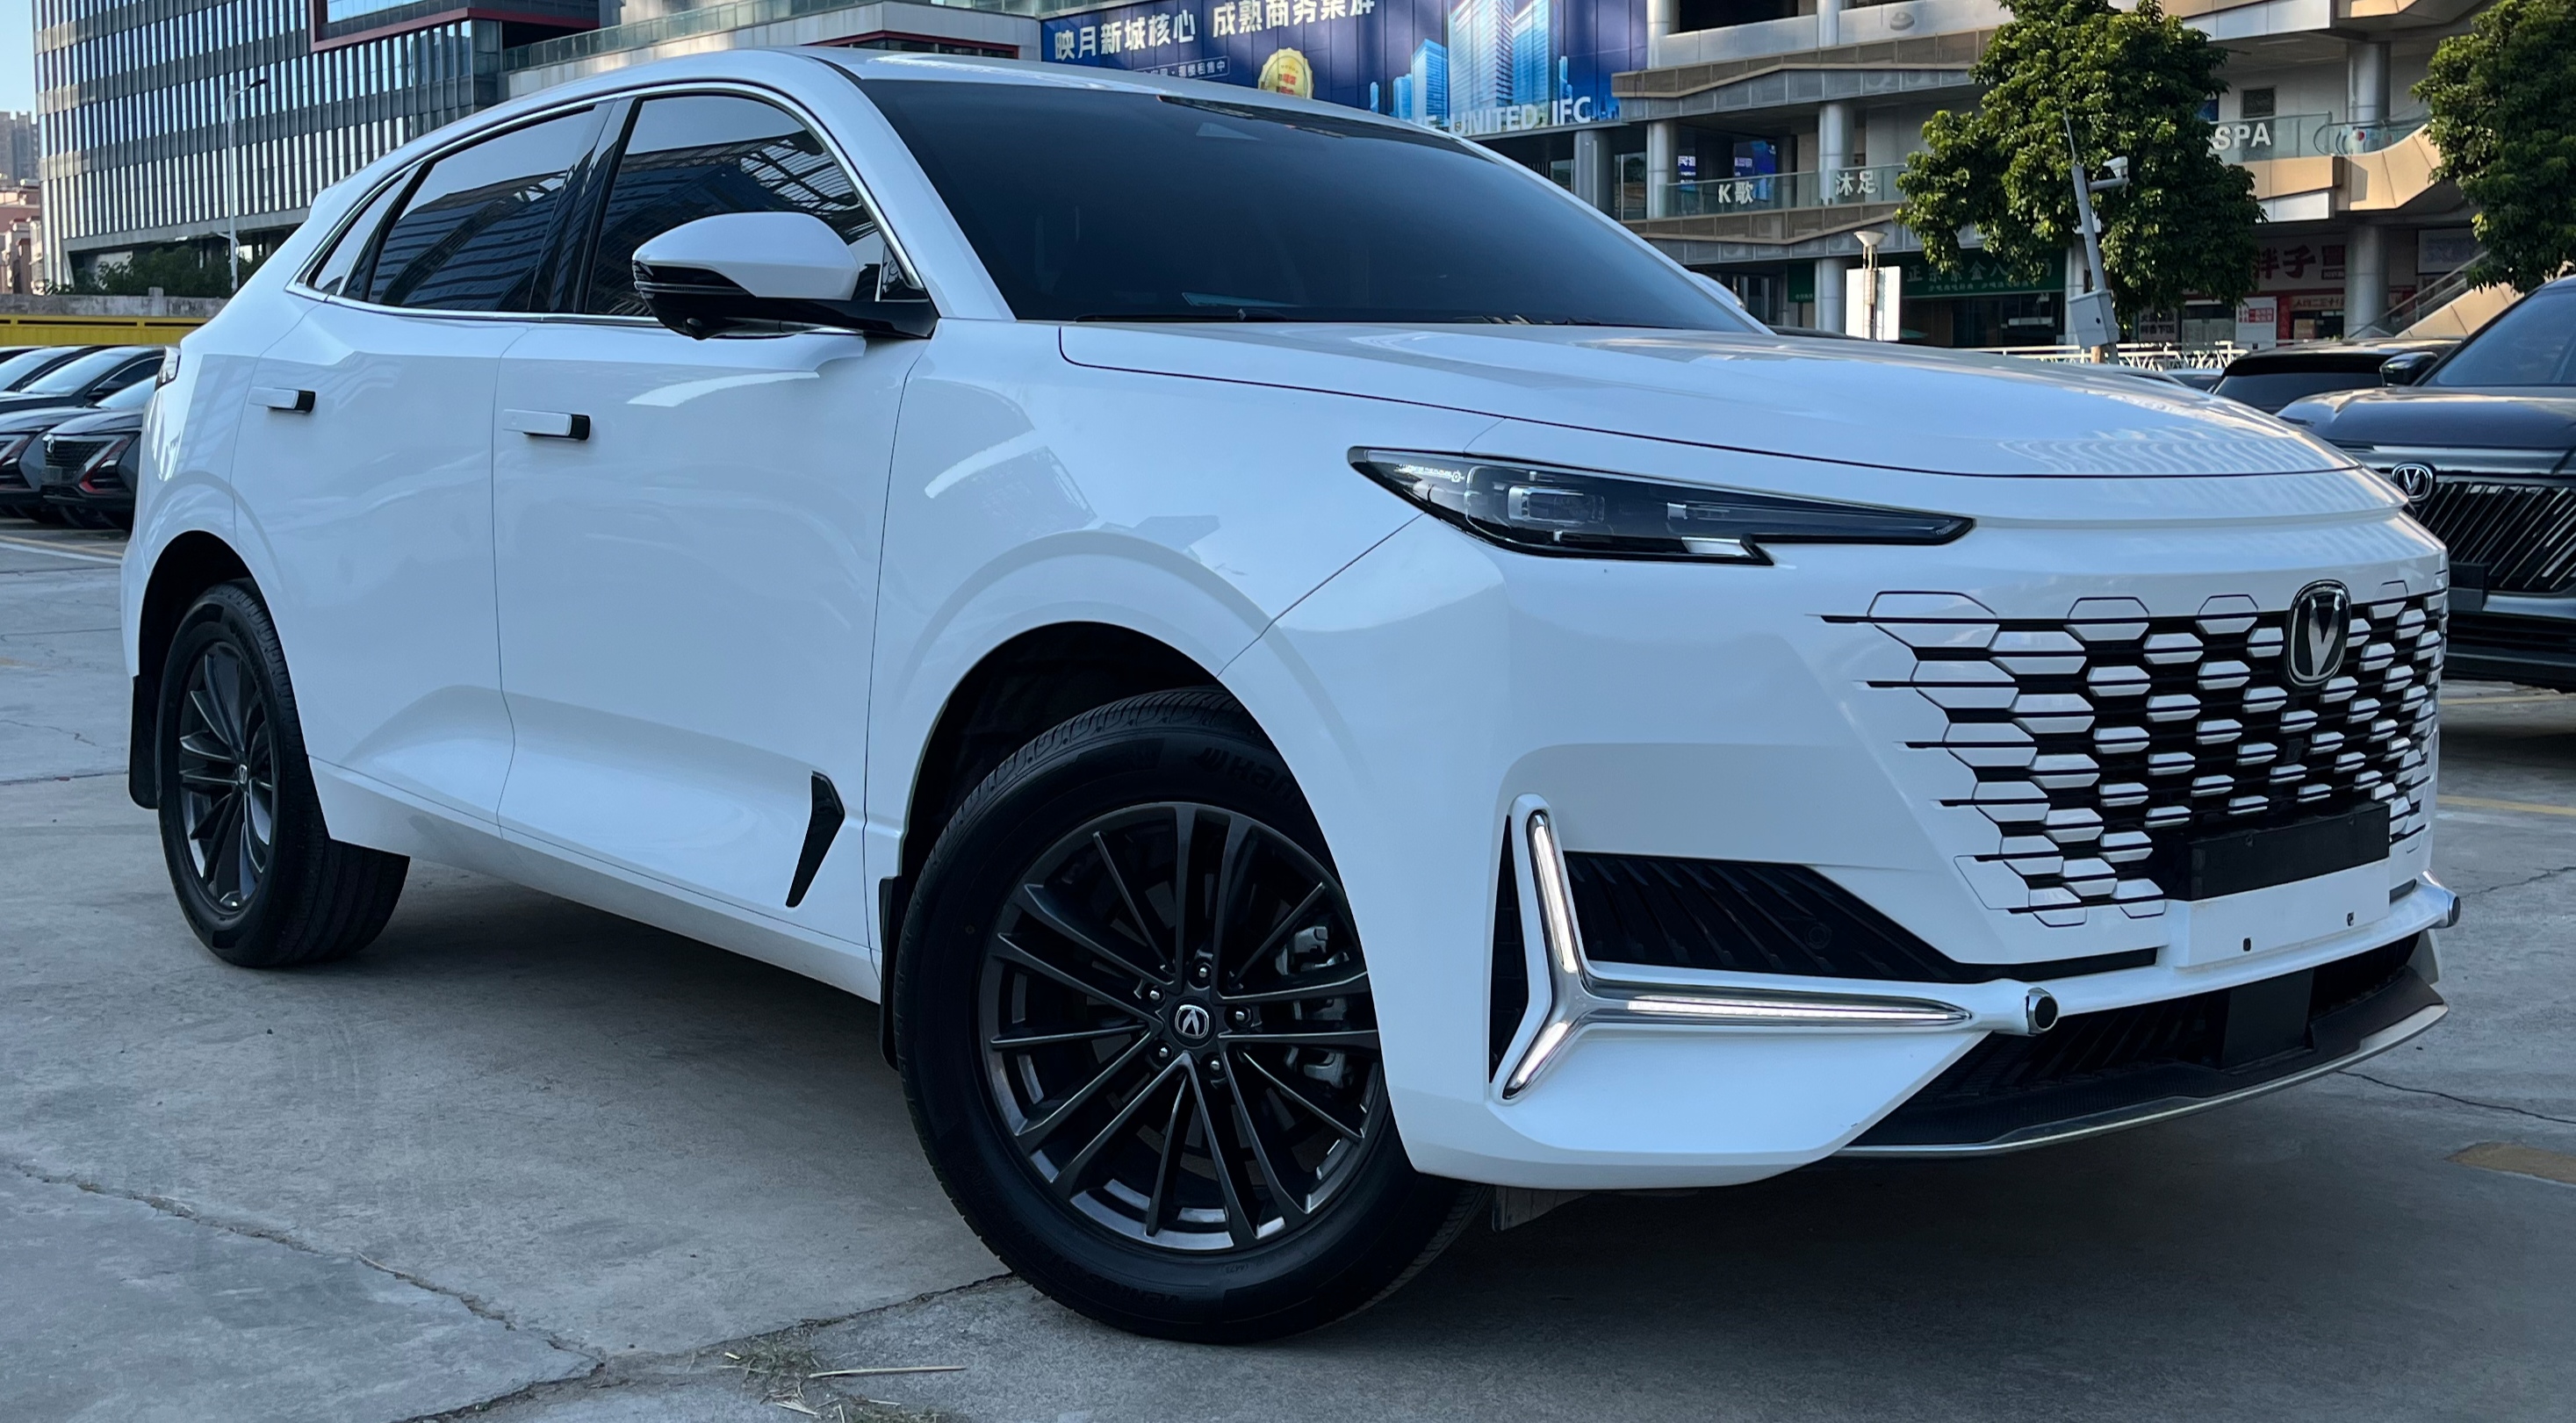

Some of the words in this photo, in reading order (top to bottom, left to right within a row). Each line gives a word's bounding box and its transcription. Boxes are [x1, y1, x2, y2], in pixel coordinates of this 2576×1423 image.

[1054, 9, 1196, 61] 映月新城核心
[1449, 104, 1537, 136] UNITED
[1551, 96, 1591, 126] IFC
[2212, 122, 2271, 150] SPA
[1718, 180, 1754, 205] K歌
[1835, 169, 1878, 196] 沐足
